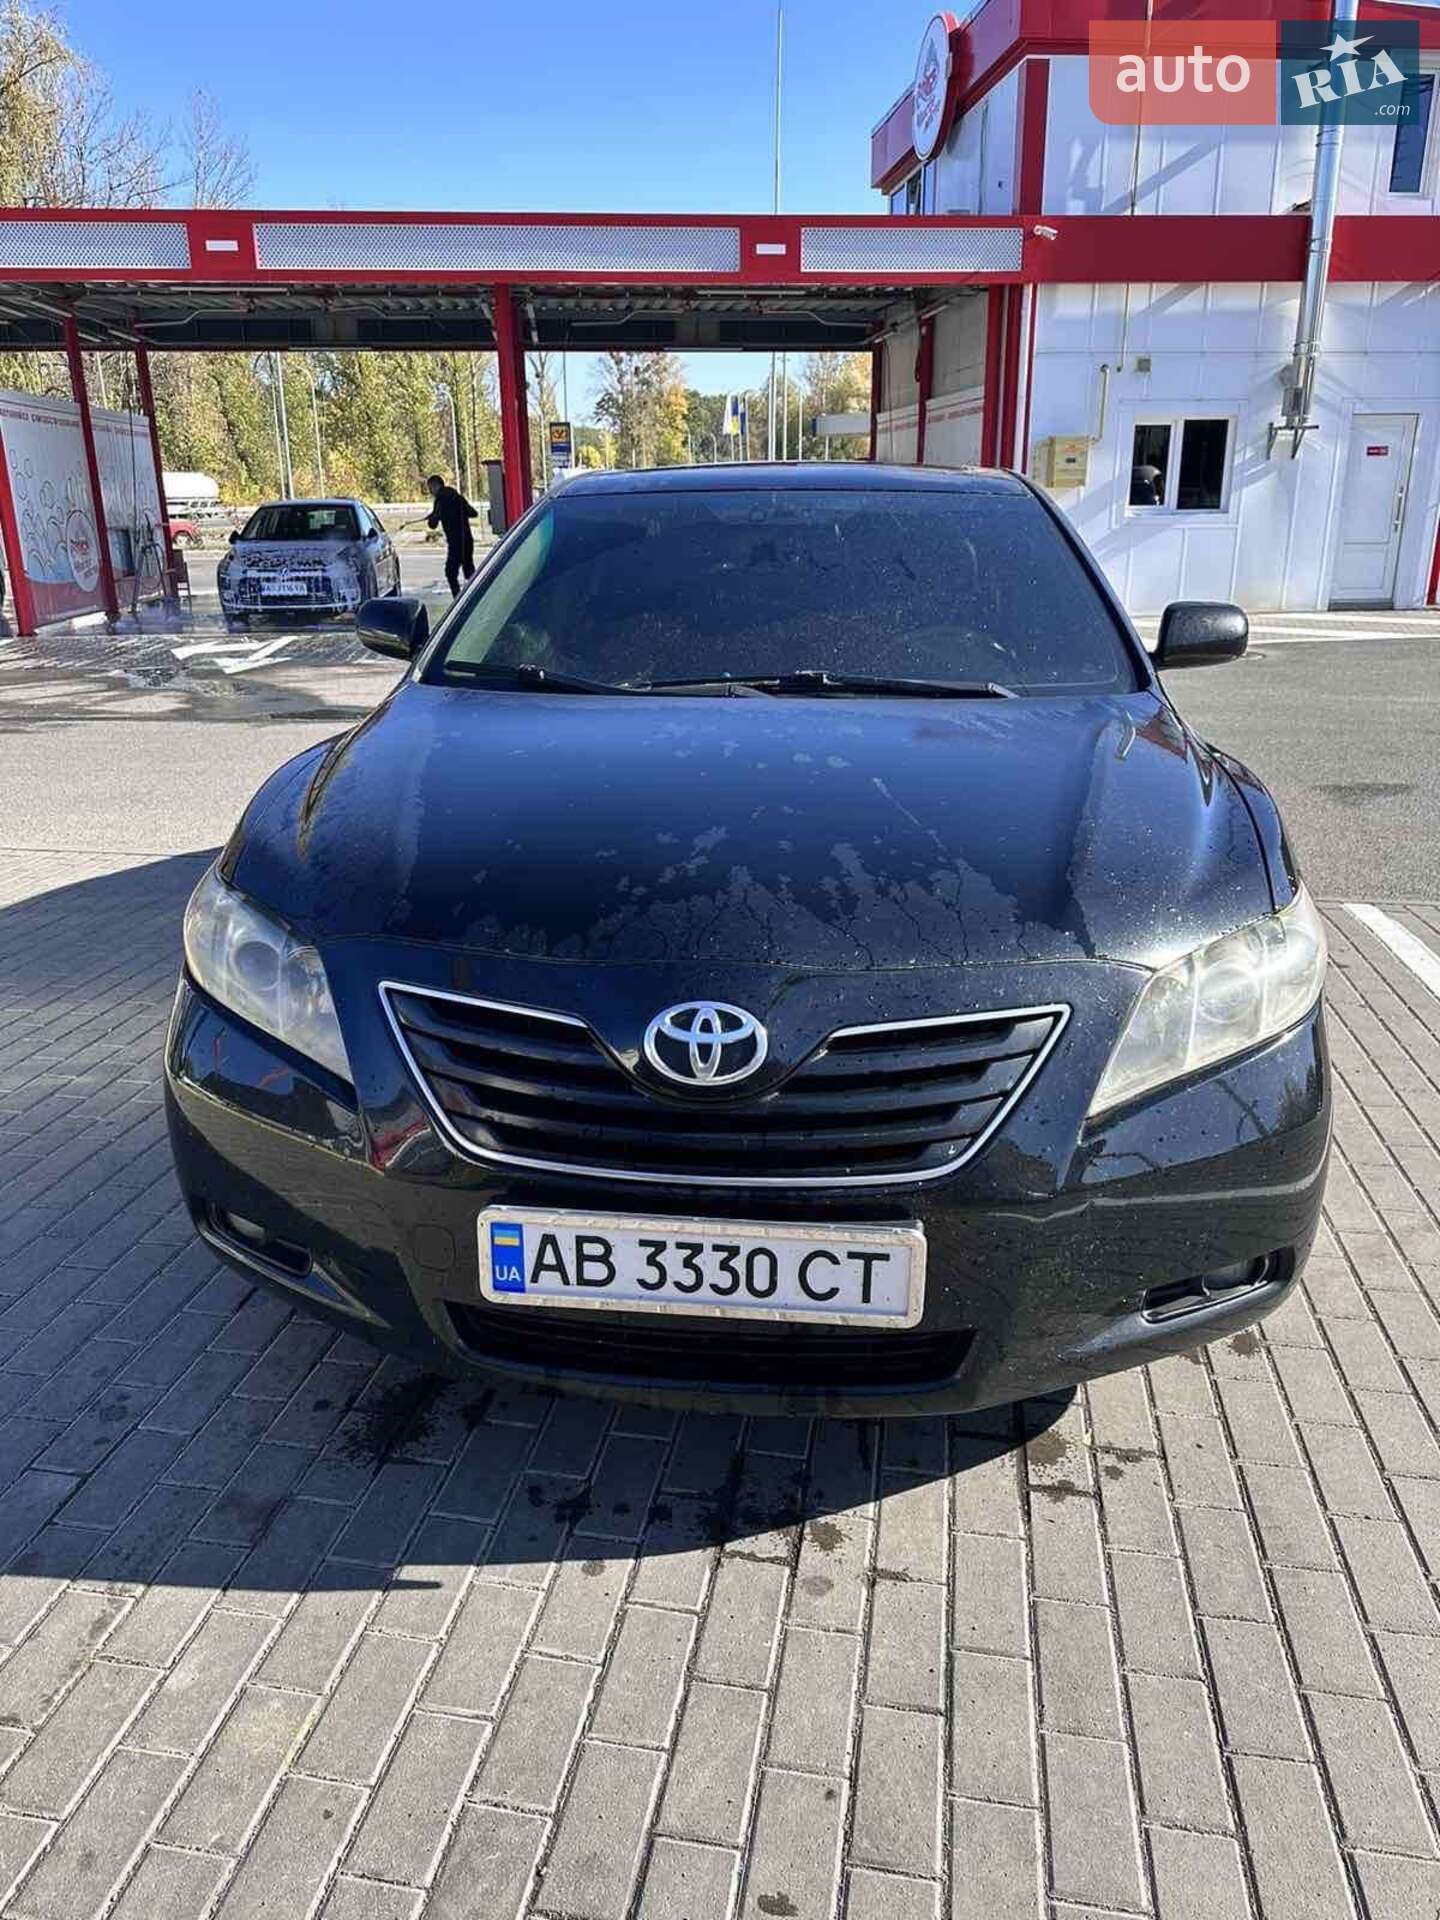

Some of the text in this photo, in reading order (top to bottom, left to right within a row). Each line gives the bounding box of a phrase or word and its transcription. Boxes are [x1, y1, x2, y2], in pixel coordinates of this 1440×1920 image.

[496, 1266, 521, 1283] UA
[530, 1233, 891, 1304] AB 3330 CT
